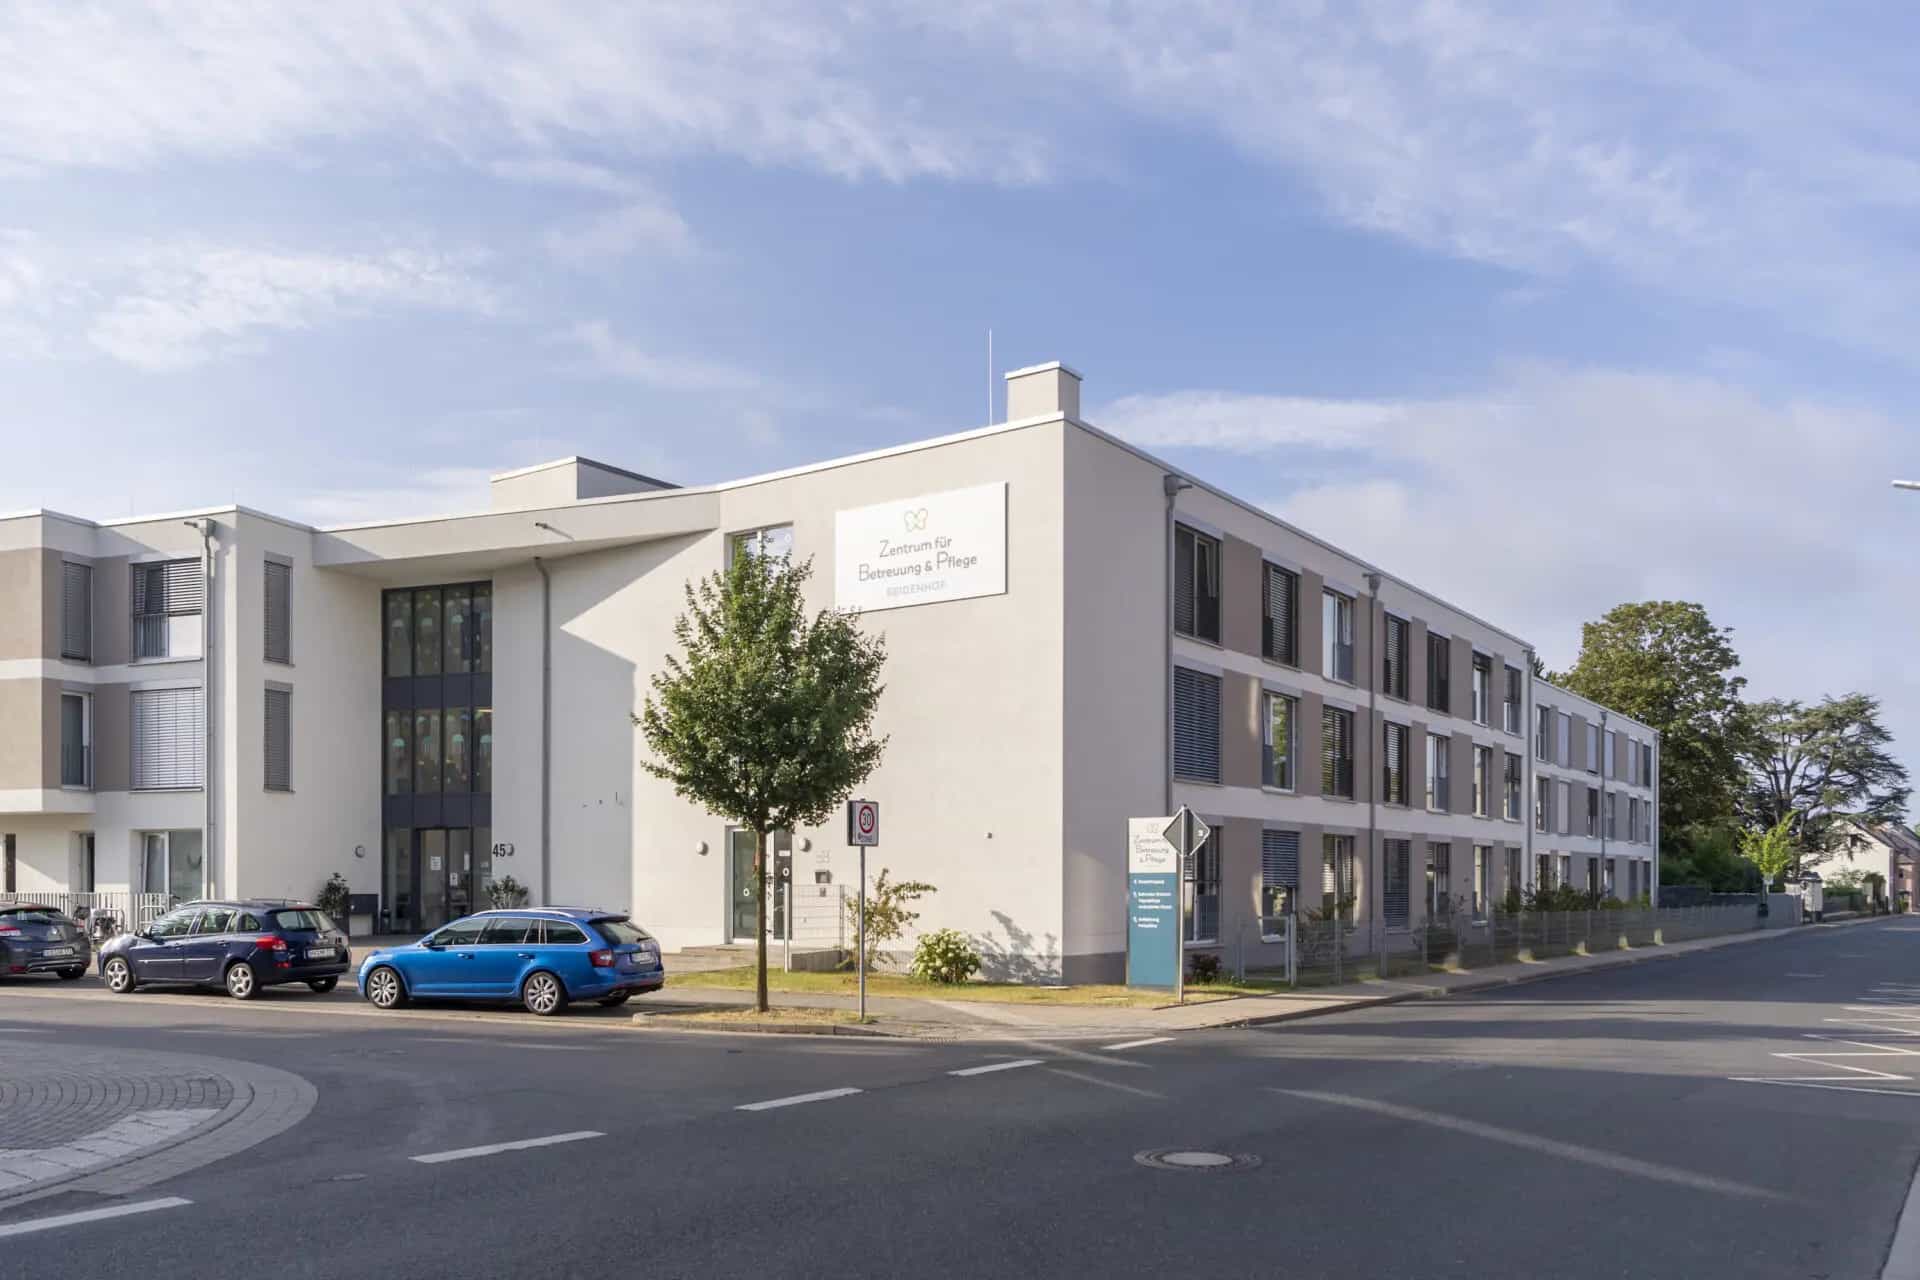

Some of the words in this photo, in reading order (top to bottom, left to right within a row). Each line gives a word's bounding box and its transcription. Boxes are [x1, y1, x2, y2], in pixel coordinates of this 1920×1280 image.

[879, 539, 932, 558] Zentrum
[935, 536, 953, 550] für
[858, 562, 921, 582] Betreuung
[924, 560, 933, 572] &
[936, 551, 977, 571] Pflege
[862, 812, 872, 826] 30
[492, 843, 506, 857] 45
